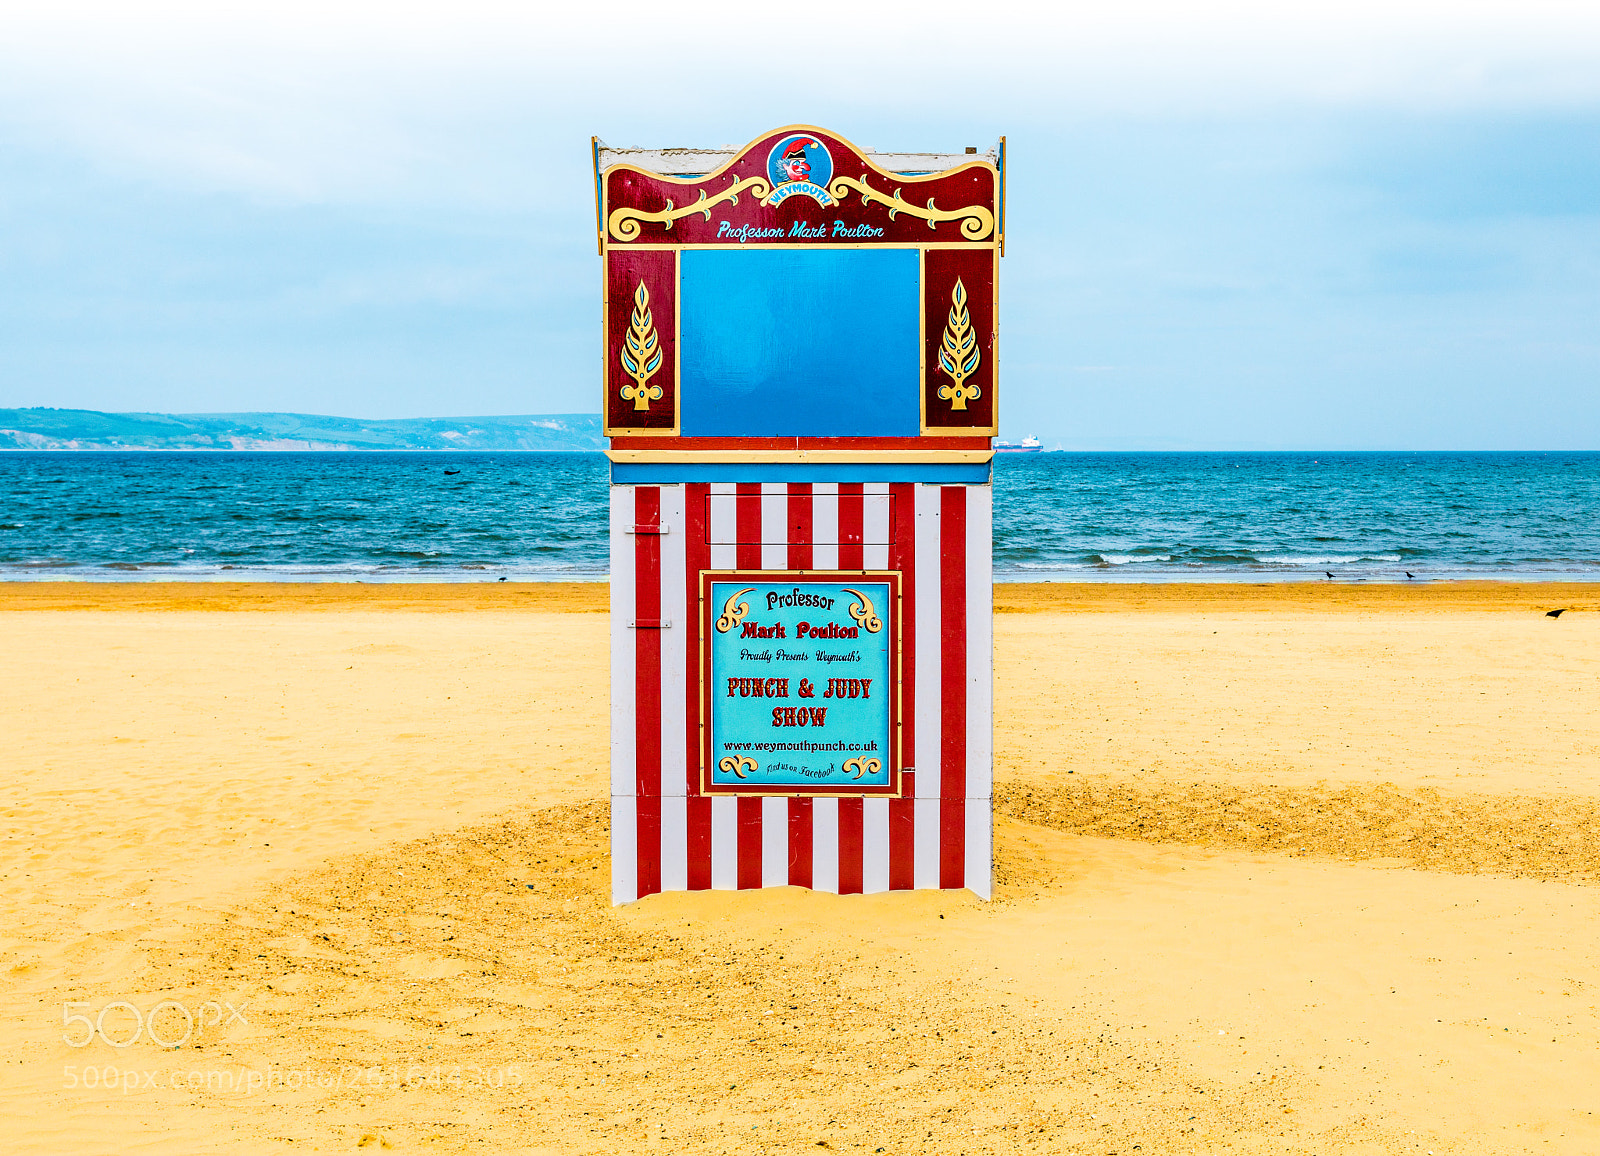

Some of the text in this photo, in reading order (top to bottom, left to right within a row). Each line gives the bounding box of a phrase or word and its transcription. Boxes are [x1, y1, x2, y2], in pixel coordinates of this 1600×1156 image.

[770, 183, 831, 203] WEYMOUTH
[717, 220, 884, 243] Professor Mark Poulton
[766, 587, 835, 611] Professor
[740, 621, 859, 640] Mark Poulton
[740, 648, 861, 664] Proudly Presents Weymouth's
[727, 677, 873, 699] PUNCH & JUDY
[772, 706, 828, 727] SHOW
[723, 740, 878, 753] www.weymouthpunch.co.uk
[799, 763, 835, 778] Facebook
